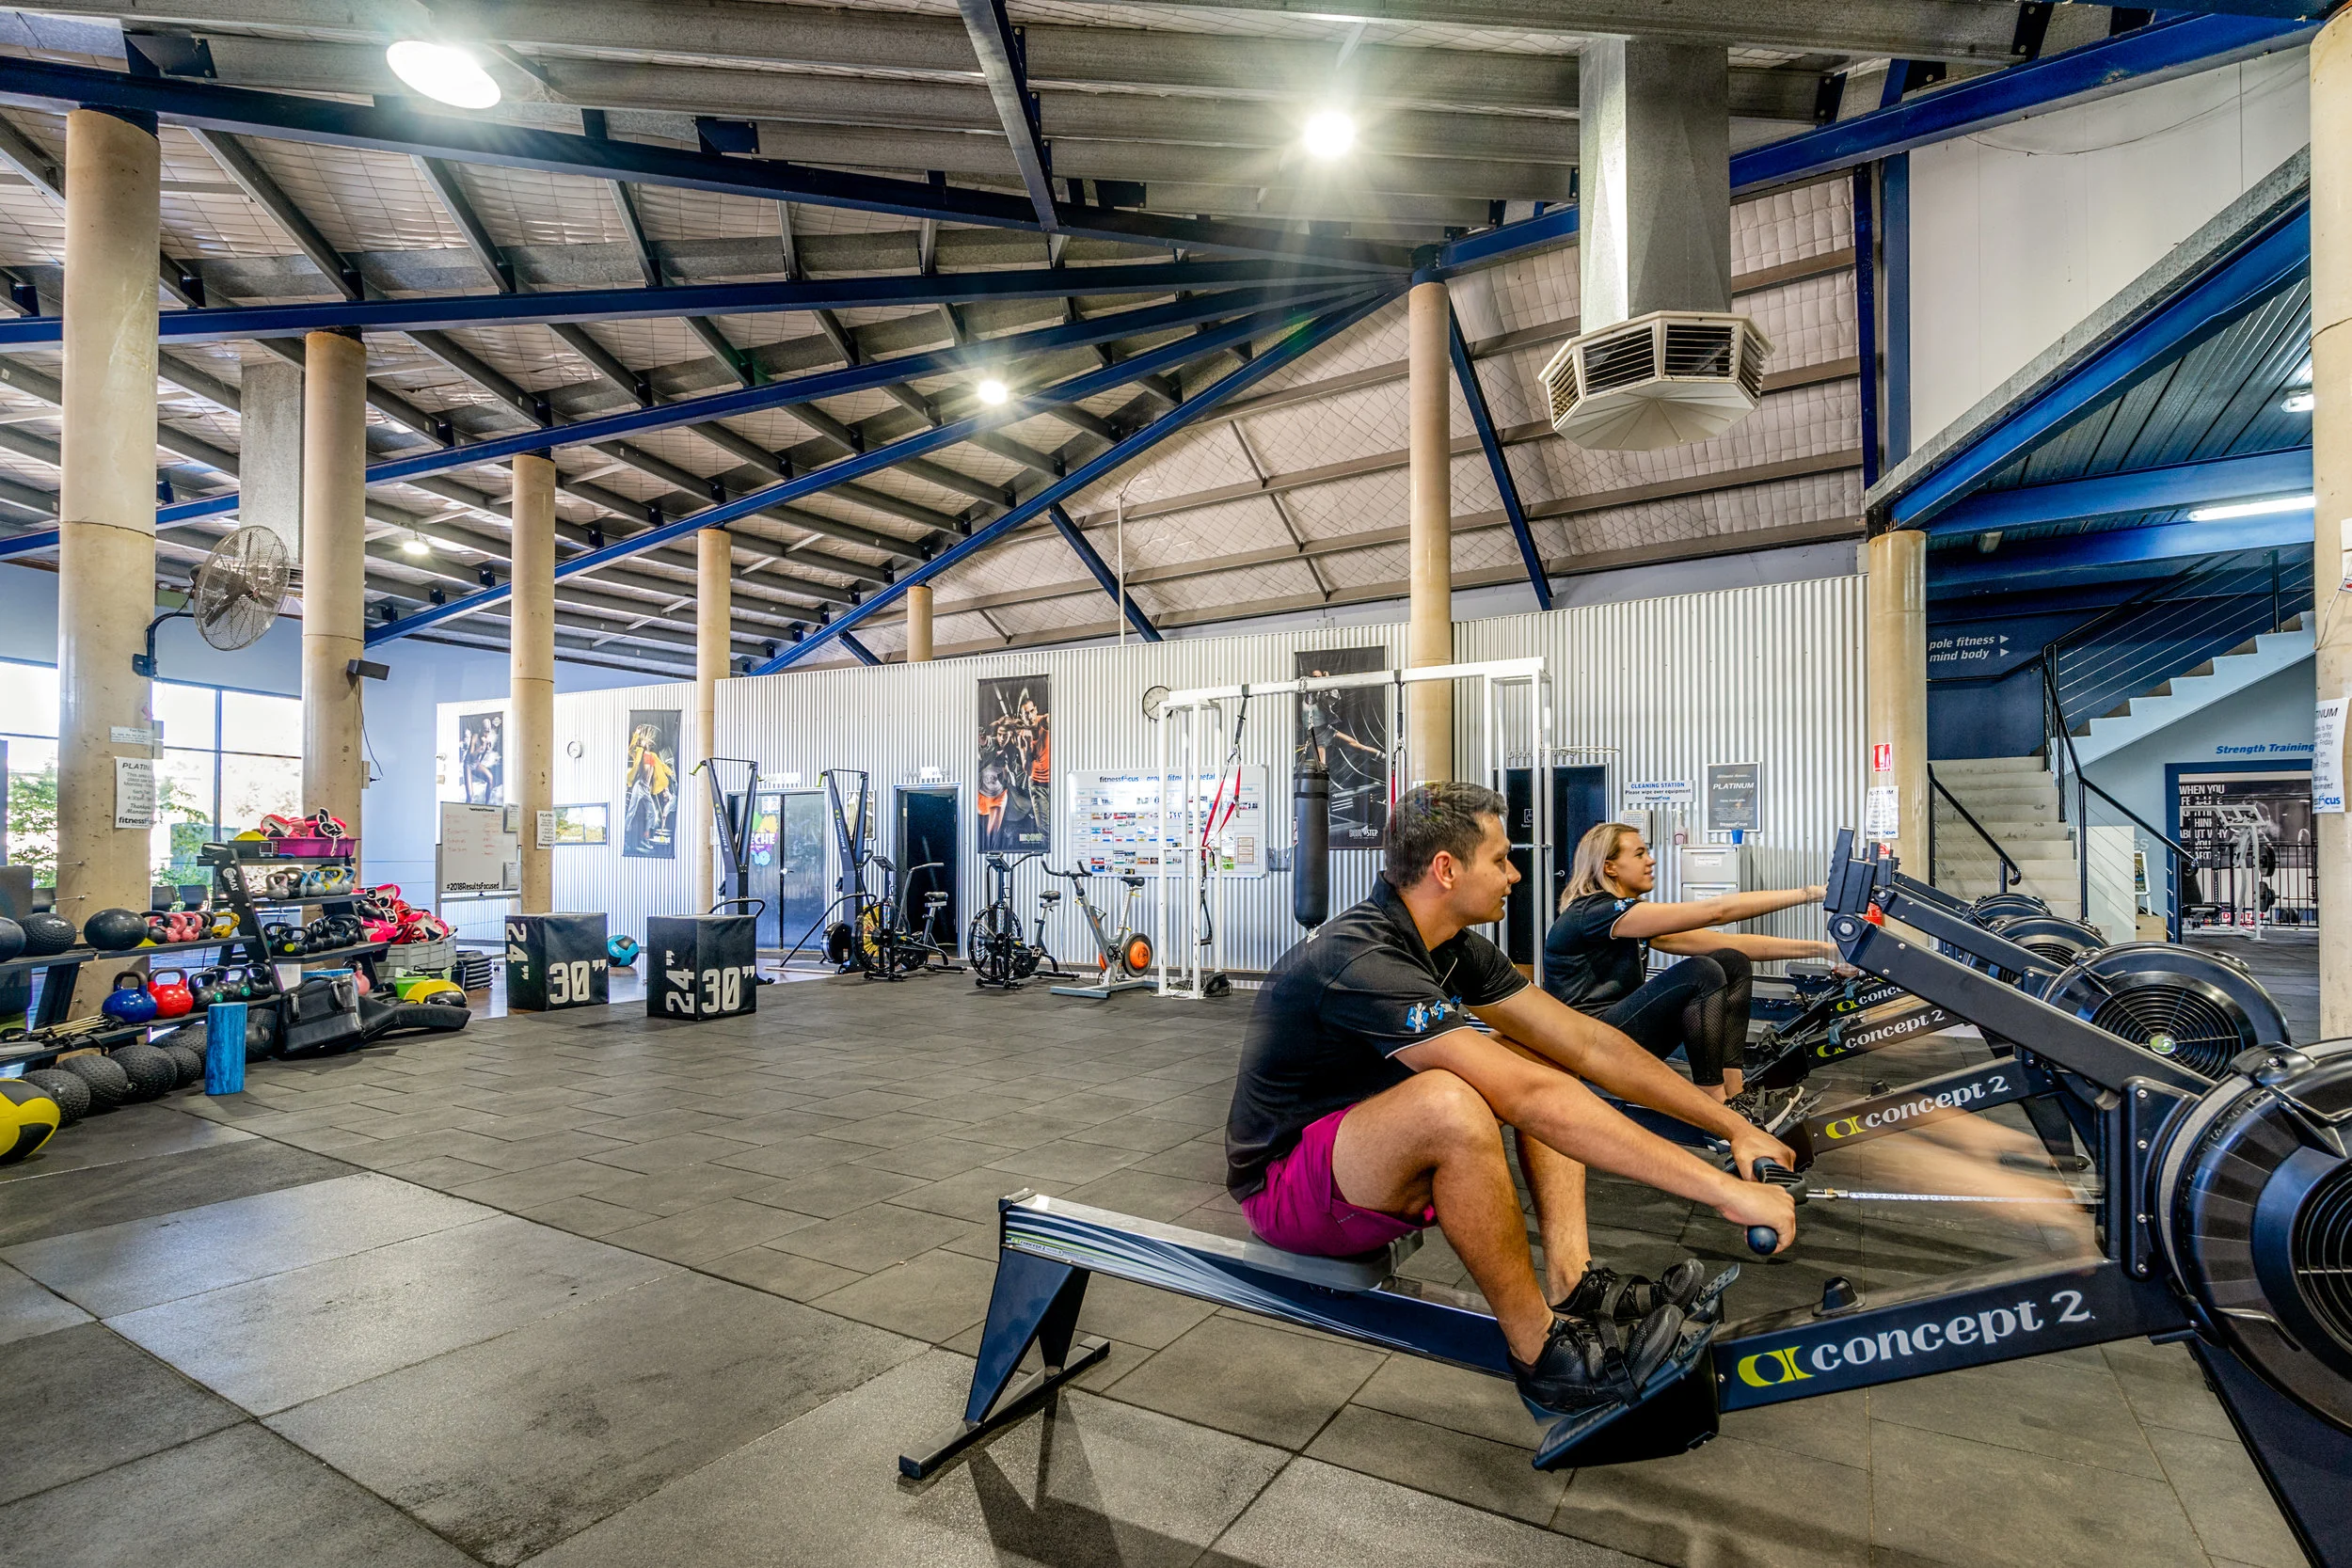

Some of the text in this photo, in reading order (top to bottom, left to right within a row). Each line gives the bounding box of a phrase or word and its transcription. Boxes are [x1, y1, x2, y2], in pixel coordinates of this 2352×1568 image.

[1929, 636, 1995, 651] pole fitness
[1929, 648, 1990, 662] mind body
[2216, 742, 2315, 755] Strength Training
[1712, 782, 1755, 790] PLATINUM
[2179, 784, 2225, 795] WHEN YOU
[446, 881, 500, 891] #2018ResultsFocused
[1858, 986, 1904, 1005] conc
[1845, 1009, 1946, 1049] concept 2
[1865, 1075, 2010, 1128] concept 2
[1811, 1290, 2090, 1371] concept 2
